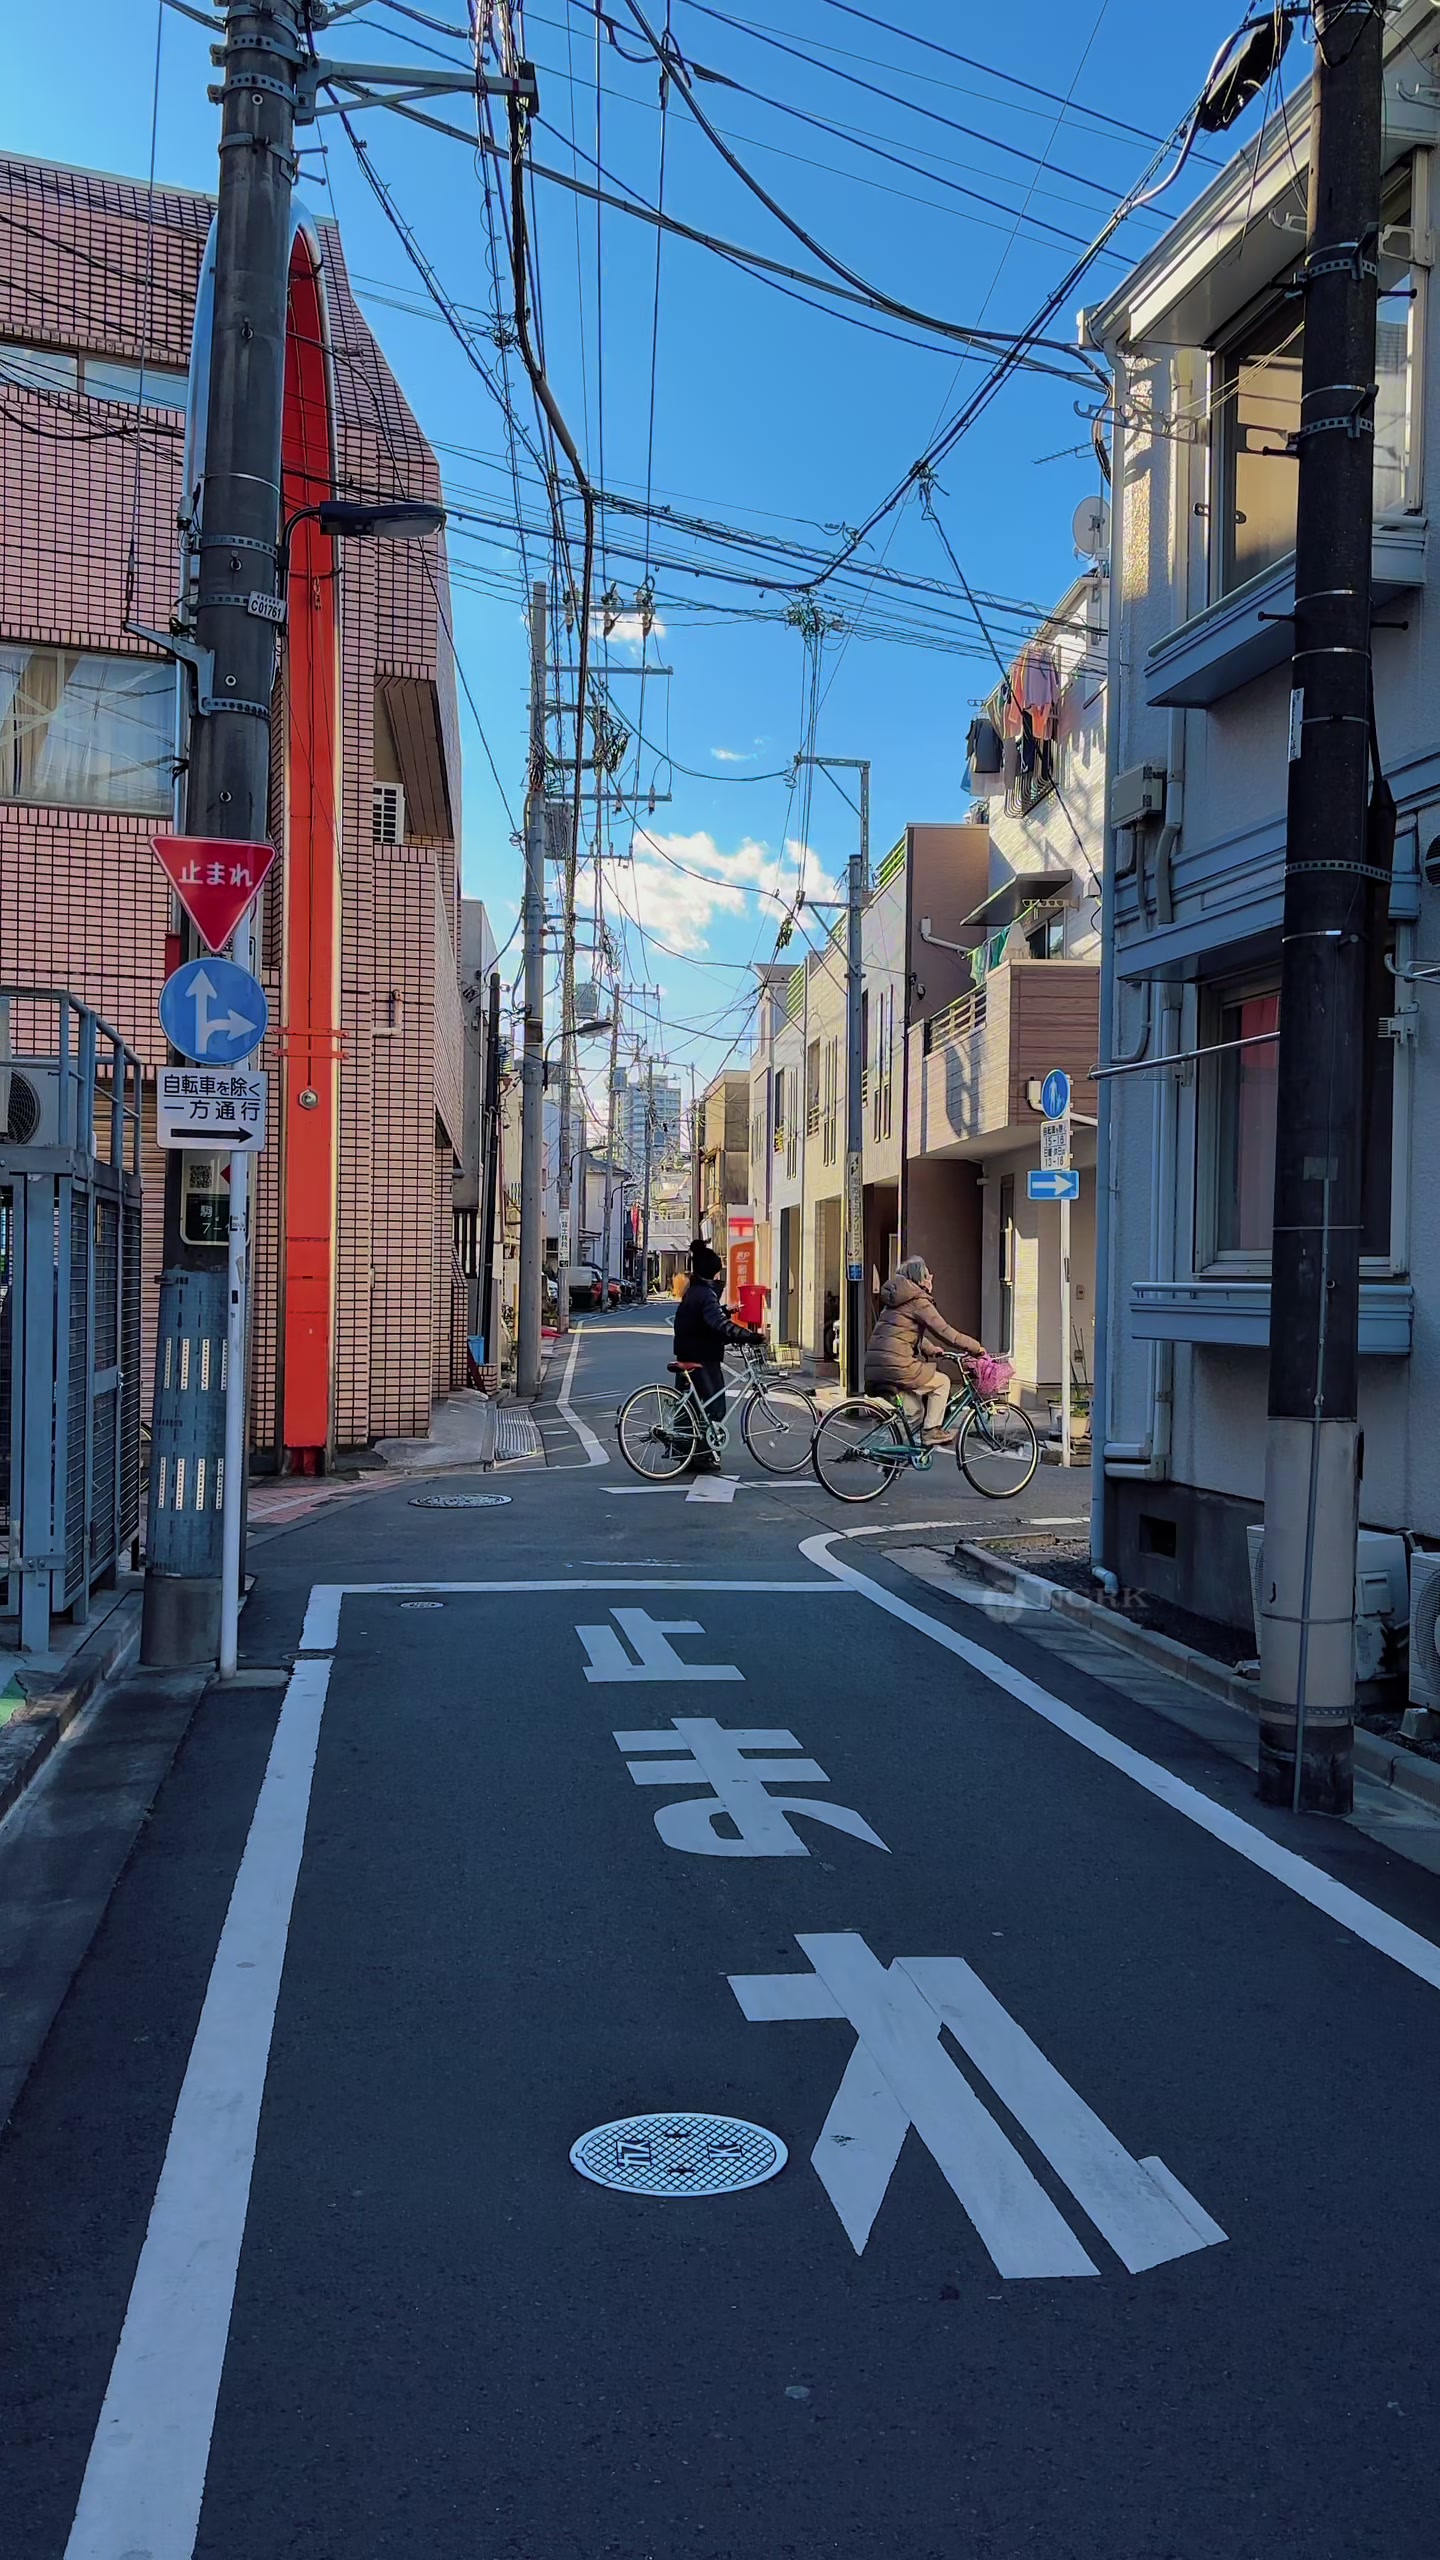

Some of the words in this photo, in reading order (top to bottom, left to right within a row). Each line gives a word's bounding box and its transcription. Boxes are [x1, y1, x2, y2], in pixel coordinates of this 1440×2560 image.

[251, 600, 281, 619] C01761
[178, 860, 253, 887] 止まれ
[164, 1074, 260, 1096] 自転車を除く
[164, 1100, 260, 1121] 一方通行
[574, 1607, 1230, 2279] 止まれ
